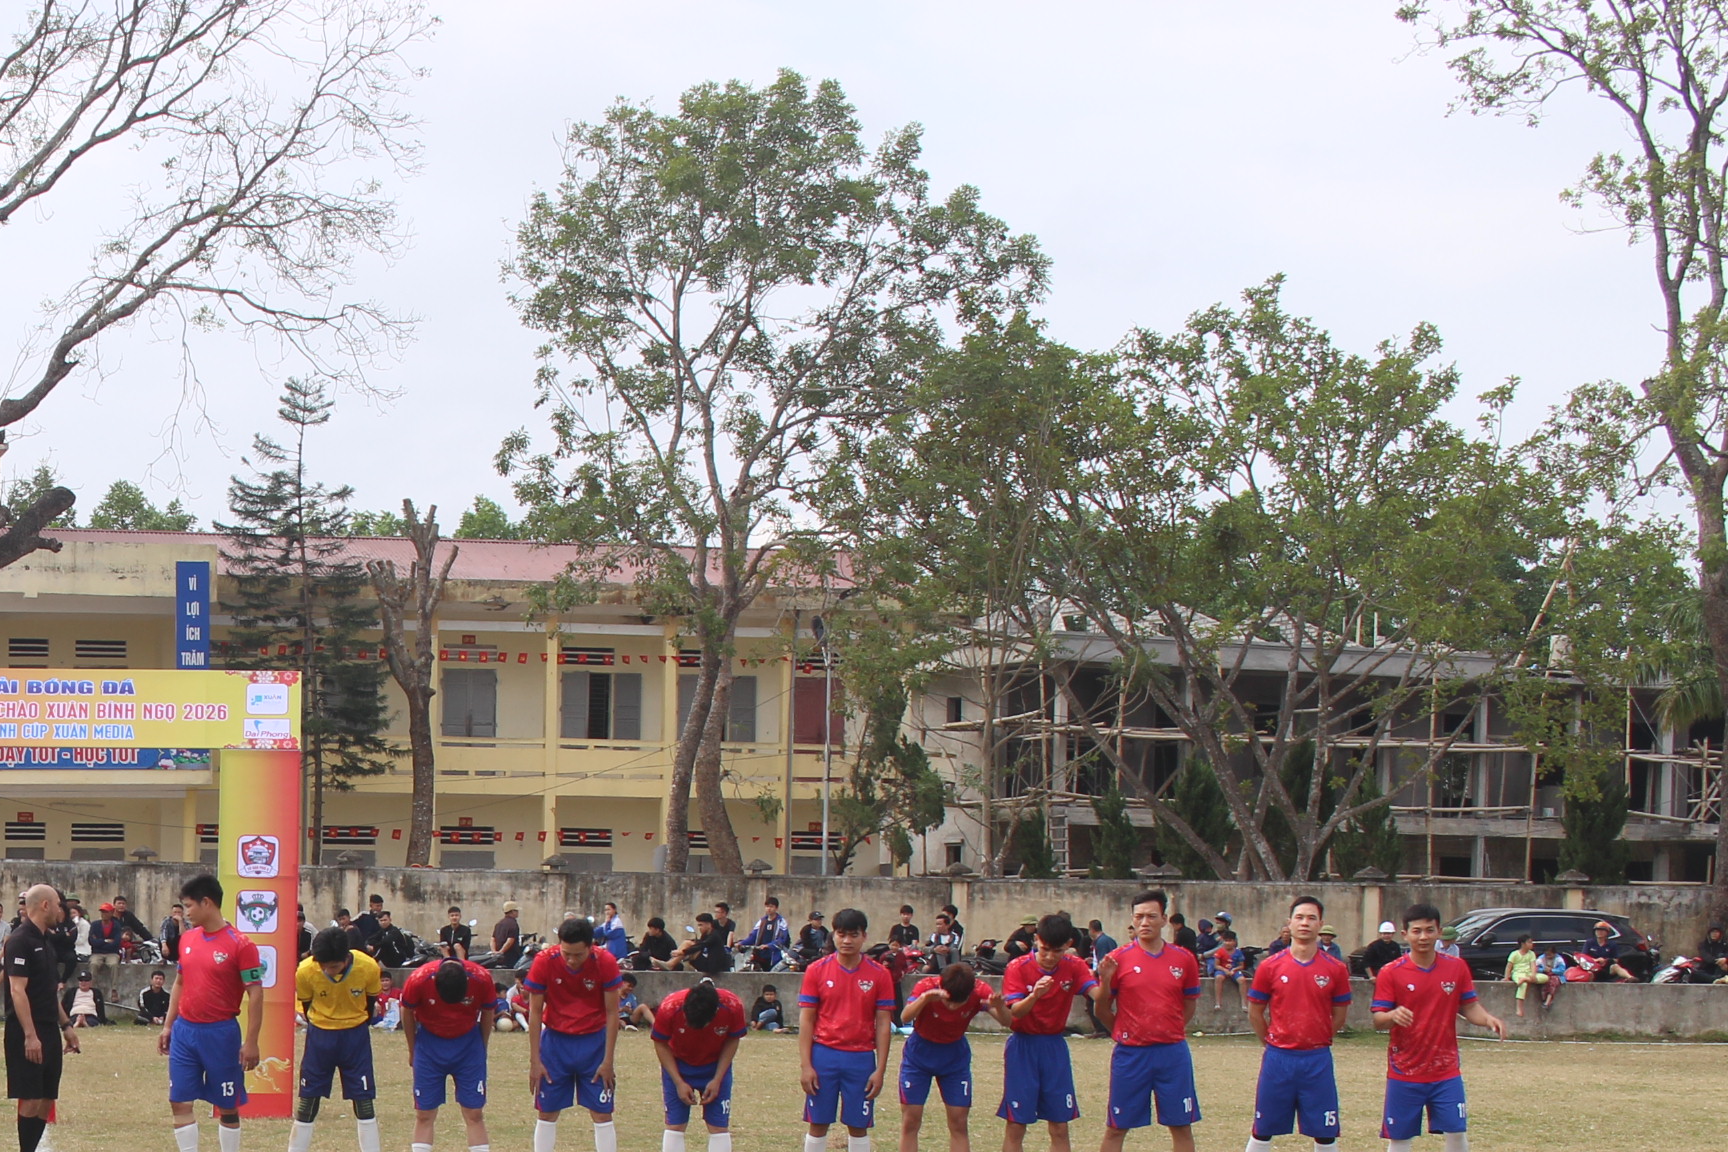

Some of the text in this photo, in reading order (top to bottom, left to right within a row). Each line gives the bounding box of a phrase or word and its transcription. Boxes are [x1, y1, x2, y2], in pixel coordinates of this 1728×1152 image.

[186, 601, 200, 618] LỢI
[186, 624, 200, 641] ÍCH
[181, 649, 205, 666] TRĂM
[26, 678, 94, 695] BÓNG
[100, 679, 136, 695] ĐÁ
[46, 700, 89, 719] XUÂN
[95, 700, 135, 719] BÍNH
[142, 702, 176, 723] NGỌ
[182, 703, 228, 721] 2026
[22, 722, 48, 739] CÚP
[53, 723, 88, 739] XUÂN
[92, 724, 134, 739] MEDIA
[260, 730, 289, 739] Phong
[249, 969, 259, 979] C
[221, 1081, 235, 1096] 13
[361, 1075, 368, 1090] 1
[477, 1080, 484, 1095] 4
[961, 1081, 969, 1096] 7
[721, 1099, 730, 1114] 19
[862, 1101, 870, 1115] 5
[1066, 1094, 1073, 1108] 8
[1183, 1097, 1192, 1113] 10
[1324, 1111, 1336, 1126] 15
